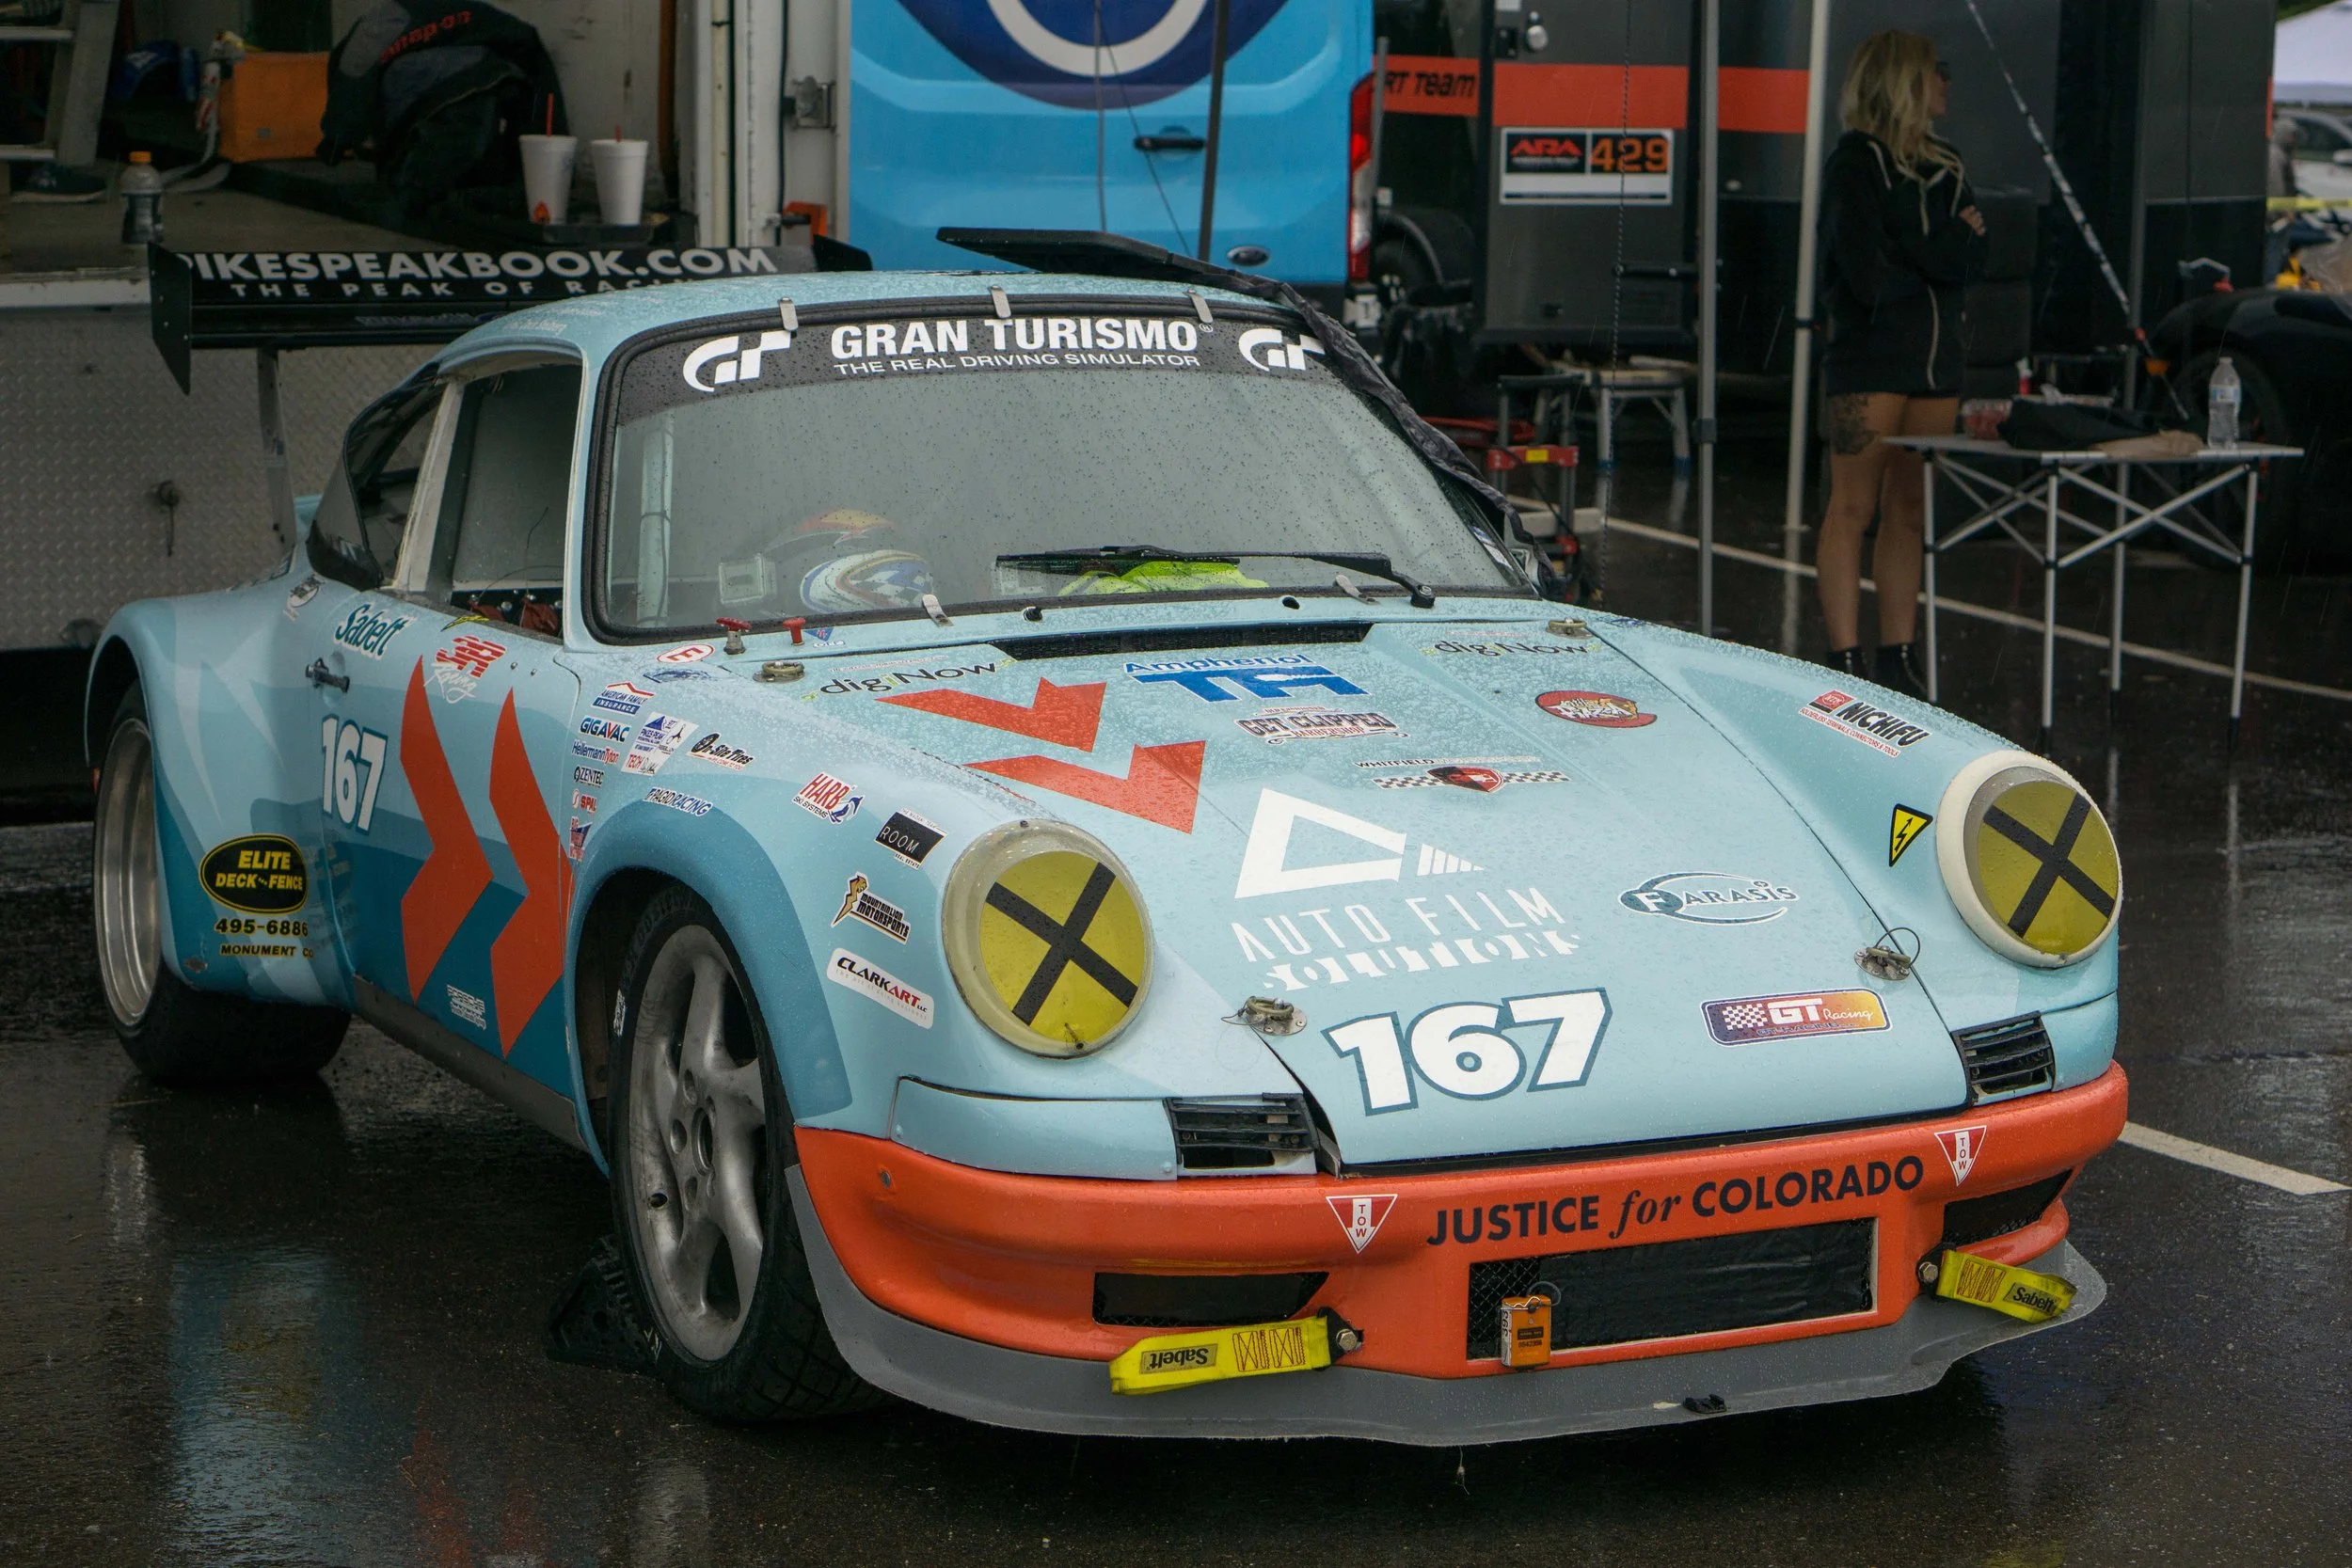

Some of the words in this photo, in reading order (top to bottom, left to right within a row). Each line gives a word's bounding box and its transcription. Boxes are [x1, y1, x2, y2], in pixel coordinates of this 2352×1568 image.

[1591, 137, 1669, 172] 429
[230, 283, 310, 297] THE
[342, 282, 454, 297] PEAK
[485, 281, 533, 296] OF
[831, 320, 969, 360] GRAN
[834, 359, 885, 376] THE
[891, 356, 957, 372] REAL
[962, 354, 1060, 369] DRIVING
[1065, 353, 1201, 367] SIMULATOR
[335, 603, 410, 657] Sabelt
[666, 646, 705, 662] E
[1126, 654, 1314, 673] Amphenol
[596, 699, 637, 714] INSURANCE
[600, 689, 627, 702] AMERICAN
[628, 693, 649, 705] FAMILY
[580, 717, 630, 743] GIGAVAC
[1238, 717, 1290, 736] GET
[1288, 712, 1398, 729] CLIPPED
[1291, 725, 1366, 738] BARBERSHOP
[1836, 701, 1931, 747] NICHIFU
[572, 741, 619, 765] HellermannTyton
[725, 748, 755, 765] Tires
[1355, 758, 1436, 768] WHITFIELD
[322, 713, 389, 836] 167
[580, 767, 605, 785] ZENTEC
[799, 773, 850, 811] HARB
[793, 796, 803, 805] SKI
[803, 800, 829, 819] SYSTEMS
[880, 826, 920, 854] ROOM
[238, 849, 292, 871] ELITE
[215, 873, 258, 889] DECK
[269, 874, 303, 891] FENCE
[215, 918, 309, 938] 495-6886
[856, 900, 910, 939] MOTORSPORTS
[1231, 904, 1392, 963] AUTO
[1405, 886, 1566, 938] FILM
[221, 943, 297, 958] MONUMENT
[1767, 997, 1823, 1025] GT
[1822, 1006, 1875, 1022] Racing
[1320, 986, 1614, 1117] 167
[1956, 1136, 1968, 1172] TOW
[1426, 1195, 1599, 1246] JUSTICE
[1609, 1188, 1681, 1240] for
[1692, 1155, 1924, 1218] COLORADO
[1355, 1203, 1368, 1238] TOW
[2012, 1286, 2058, 1317] Sabelt
[1149, 1347, 1210, 1370] Sabelt
